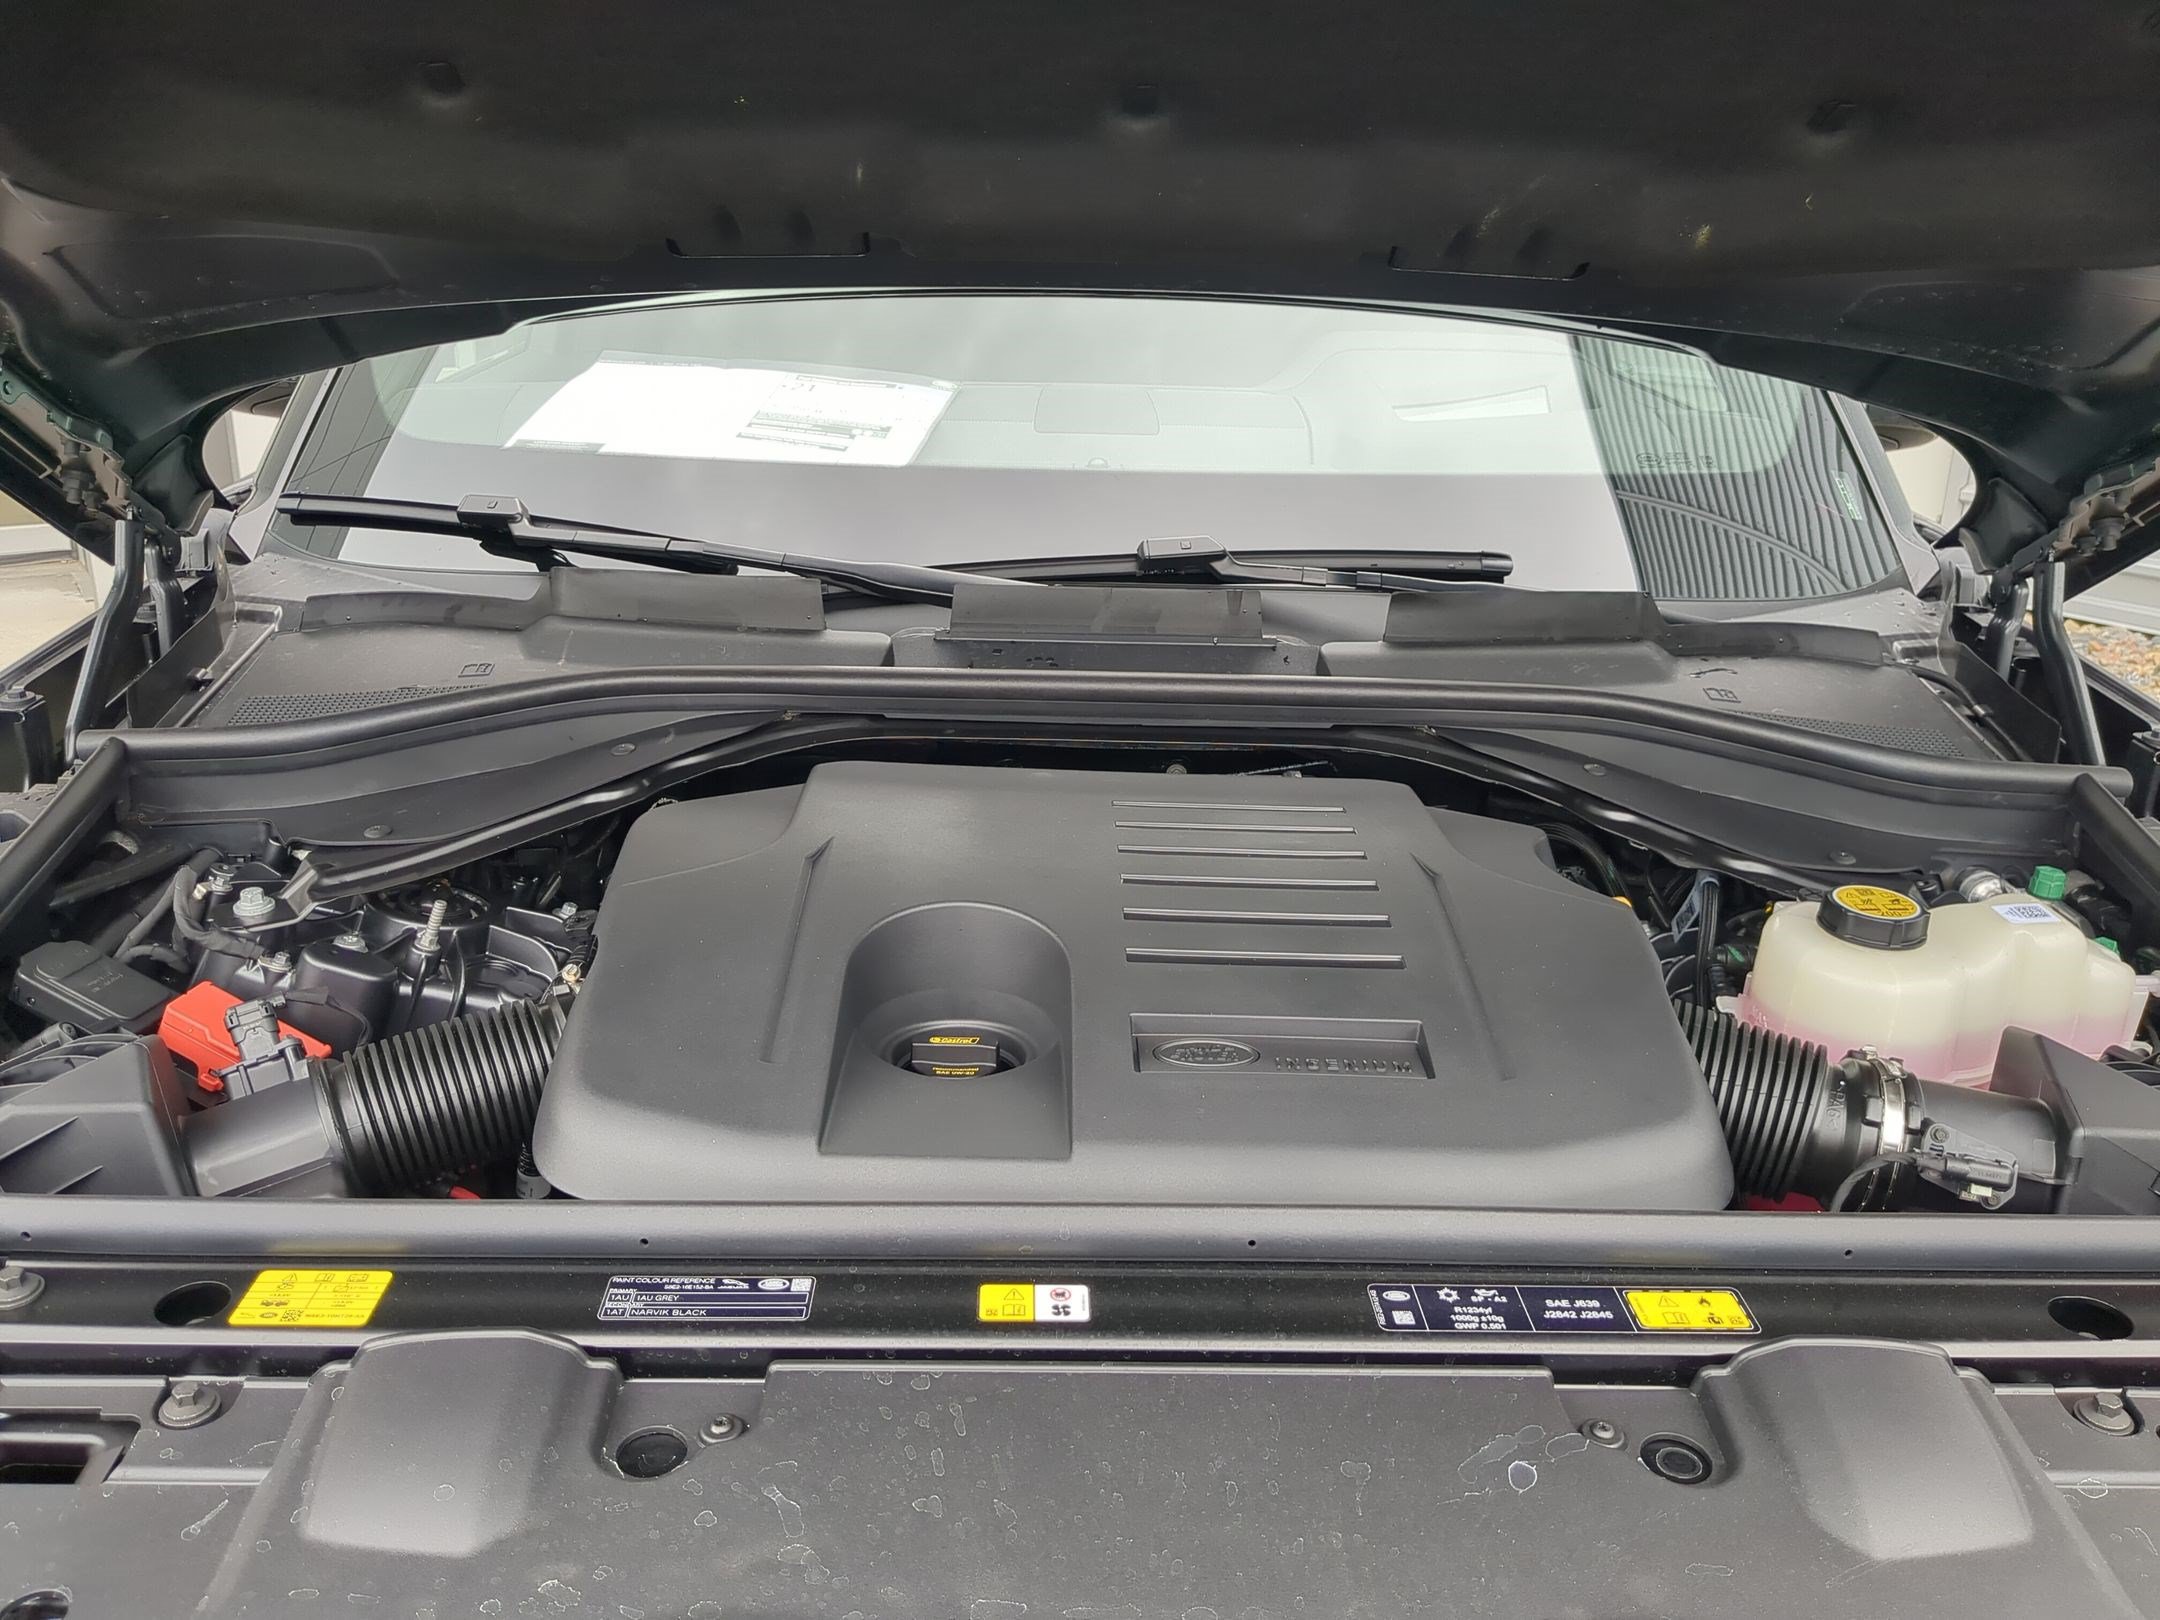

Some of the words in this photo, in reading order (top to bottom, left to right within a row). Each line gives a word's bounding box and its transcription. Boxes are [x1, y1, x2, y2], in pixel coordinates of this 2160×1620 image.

[1275, 1057, 1413, 1073] INGENIUM
[1545, 1299, 1572, 1308] SAE
[1450, 1314, 1480, 1323] 1000g
[1454, 1322, 1479, 1330] GWP
[1480, 1322, 1507, 1330] 0.501
